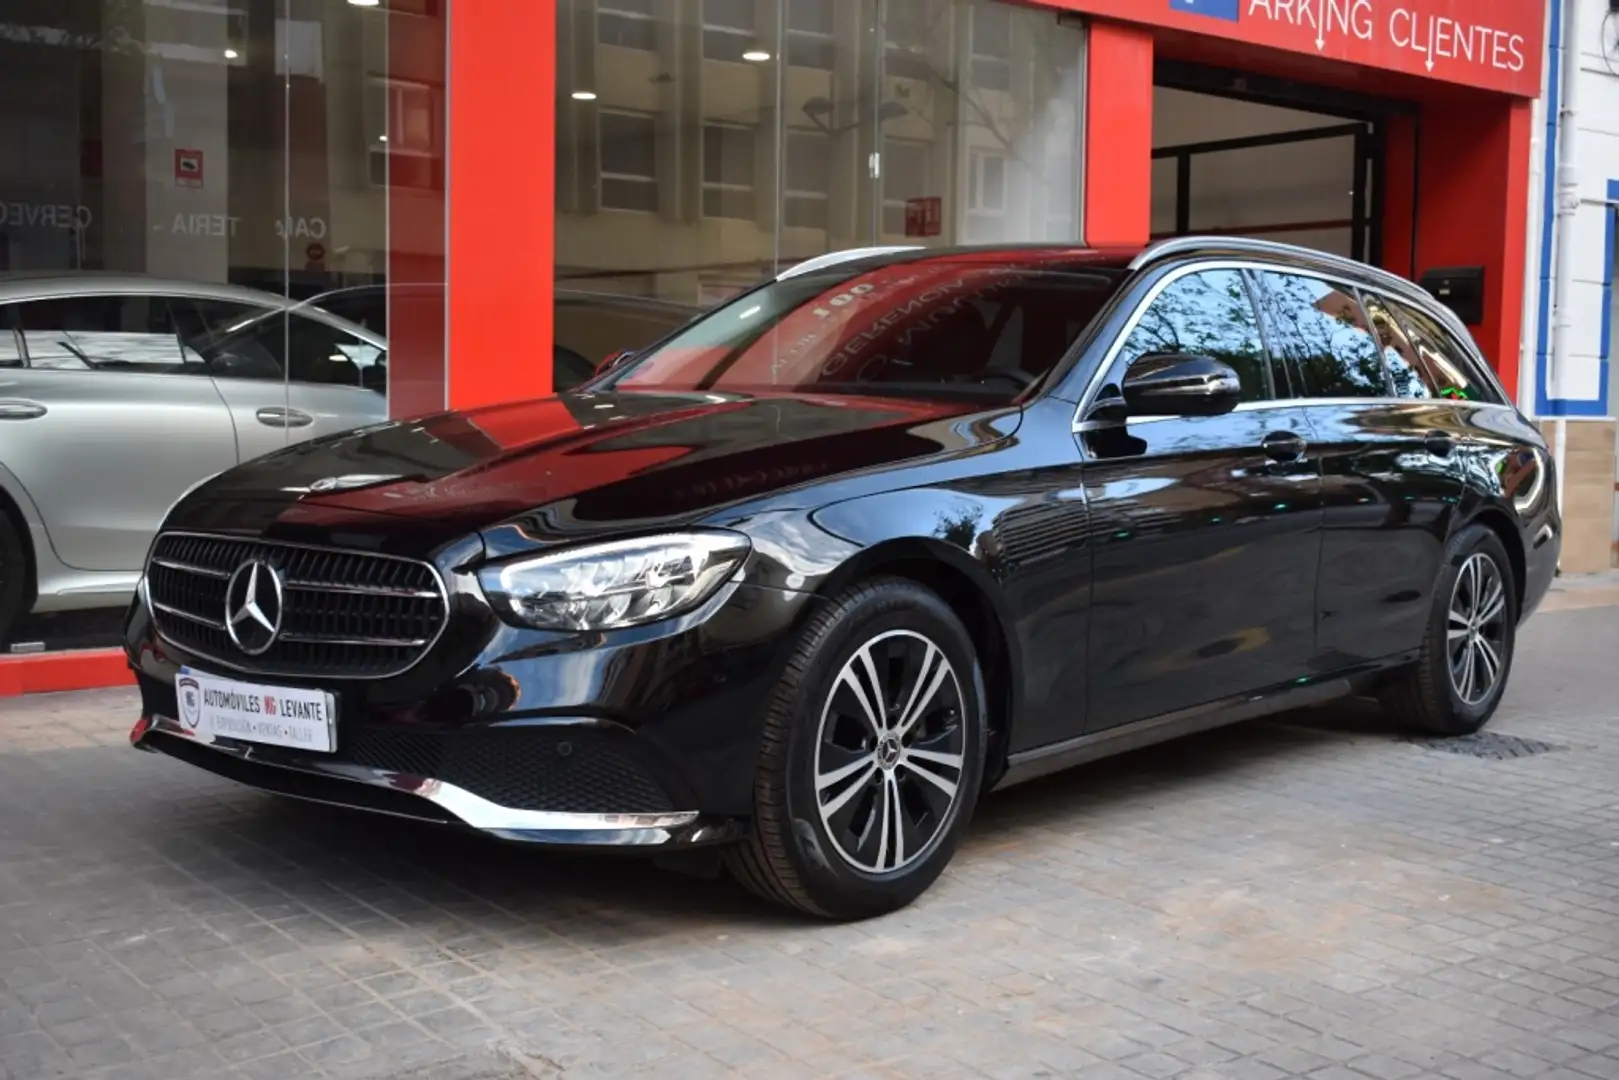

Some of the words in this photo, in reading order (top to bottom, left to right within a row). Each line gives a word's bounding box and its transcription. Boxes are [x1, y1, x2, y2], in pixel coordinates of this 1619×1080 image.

[1389, 9, 1525, 72] CLIENTES
[203, 688, 261, 713] AUTOMÓVILES
[279, 698, 323, 721] LEVANTE
